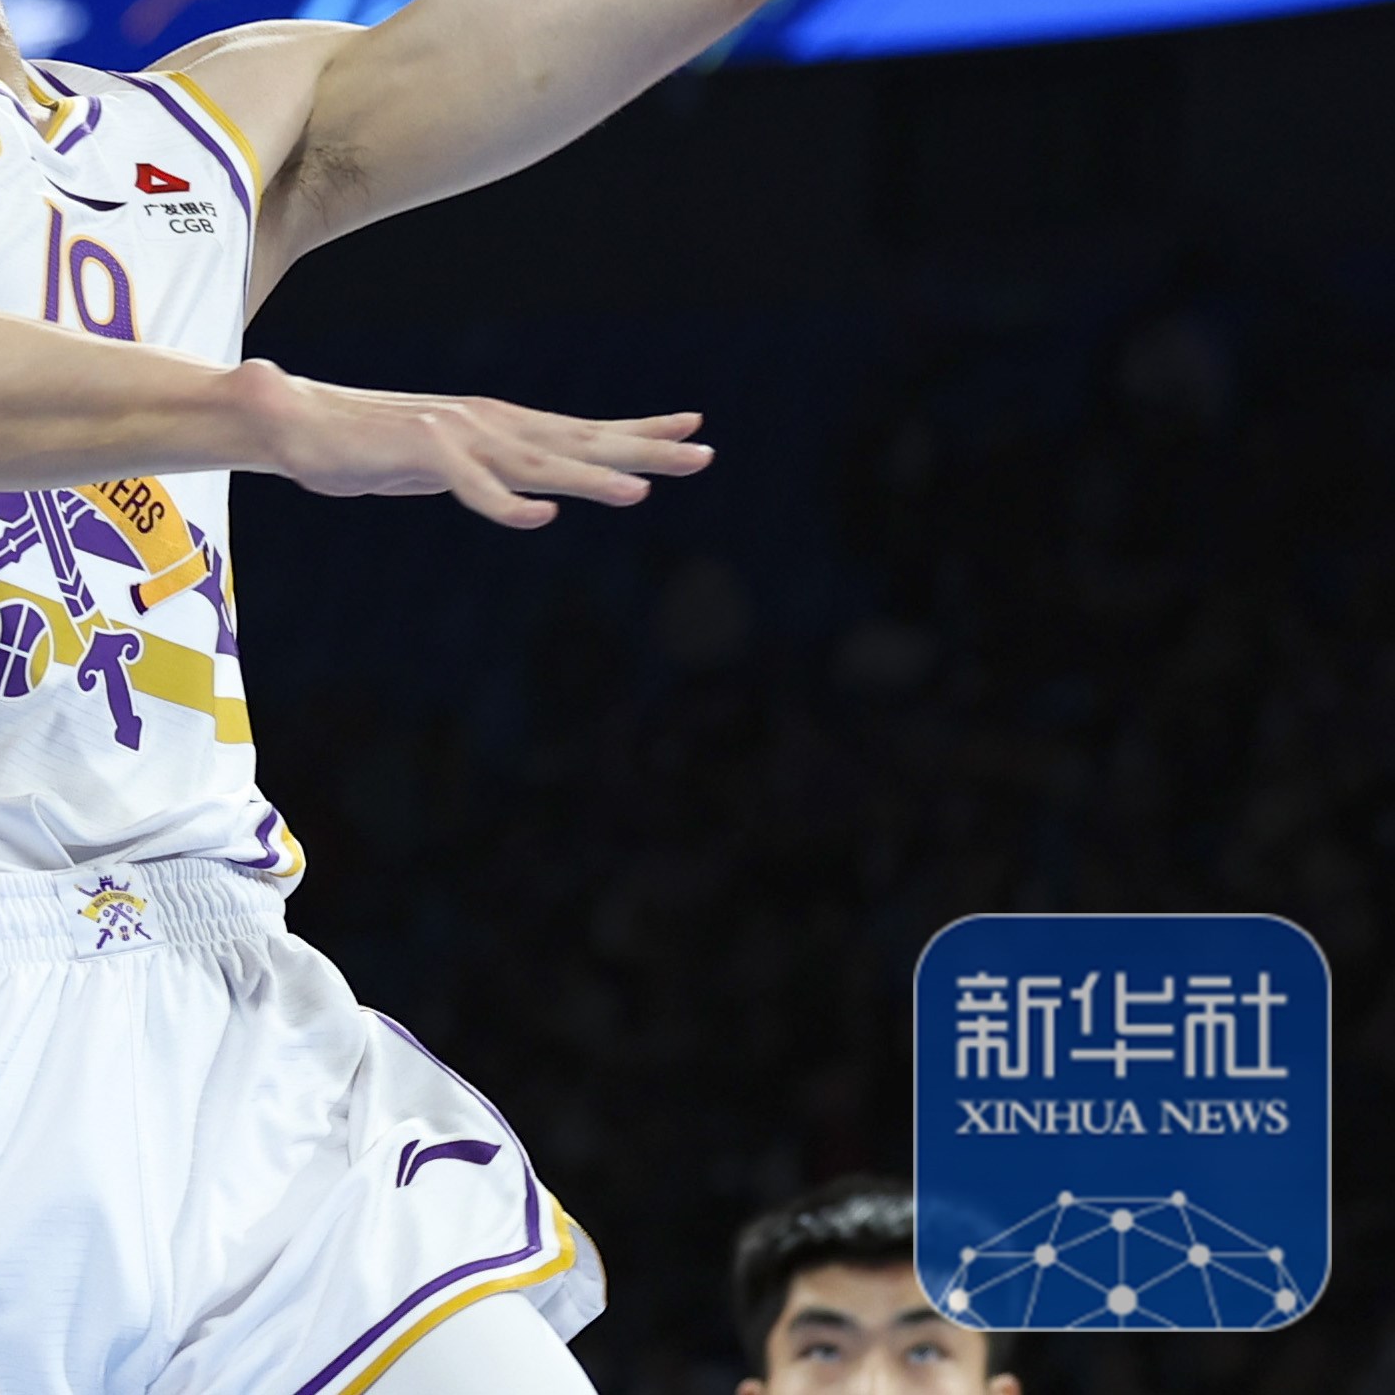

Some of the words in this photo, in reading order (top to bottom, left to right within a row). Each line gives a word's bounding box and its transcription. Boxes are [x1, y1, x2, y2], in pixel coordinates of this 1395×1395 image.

[142, 201, 218, 217] 广发银行
[169, 218, 215, 234] CGB
